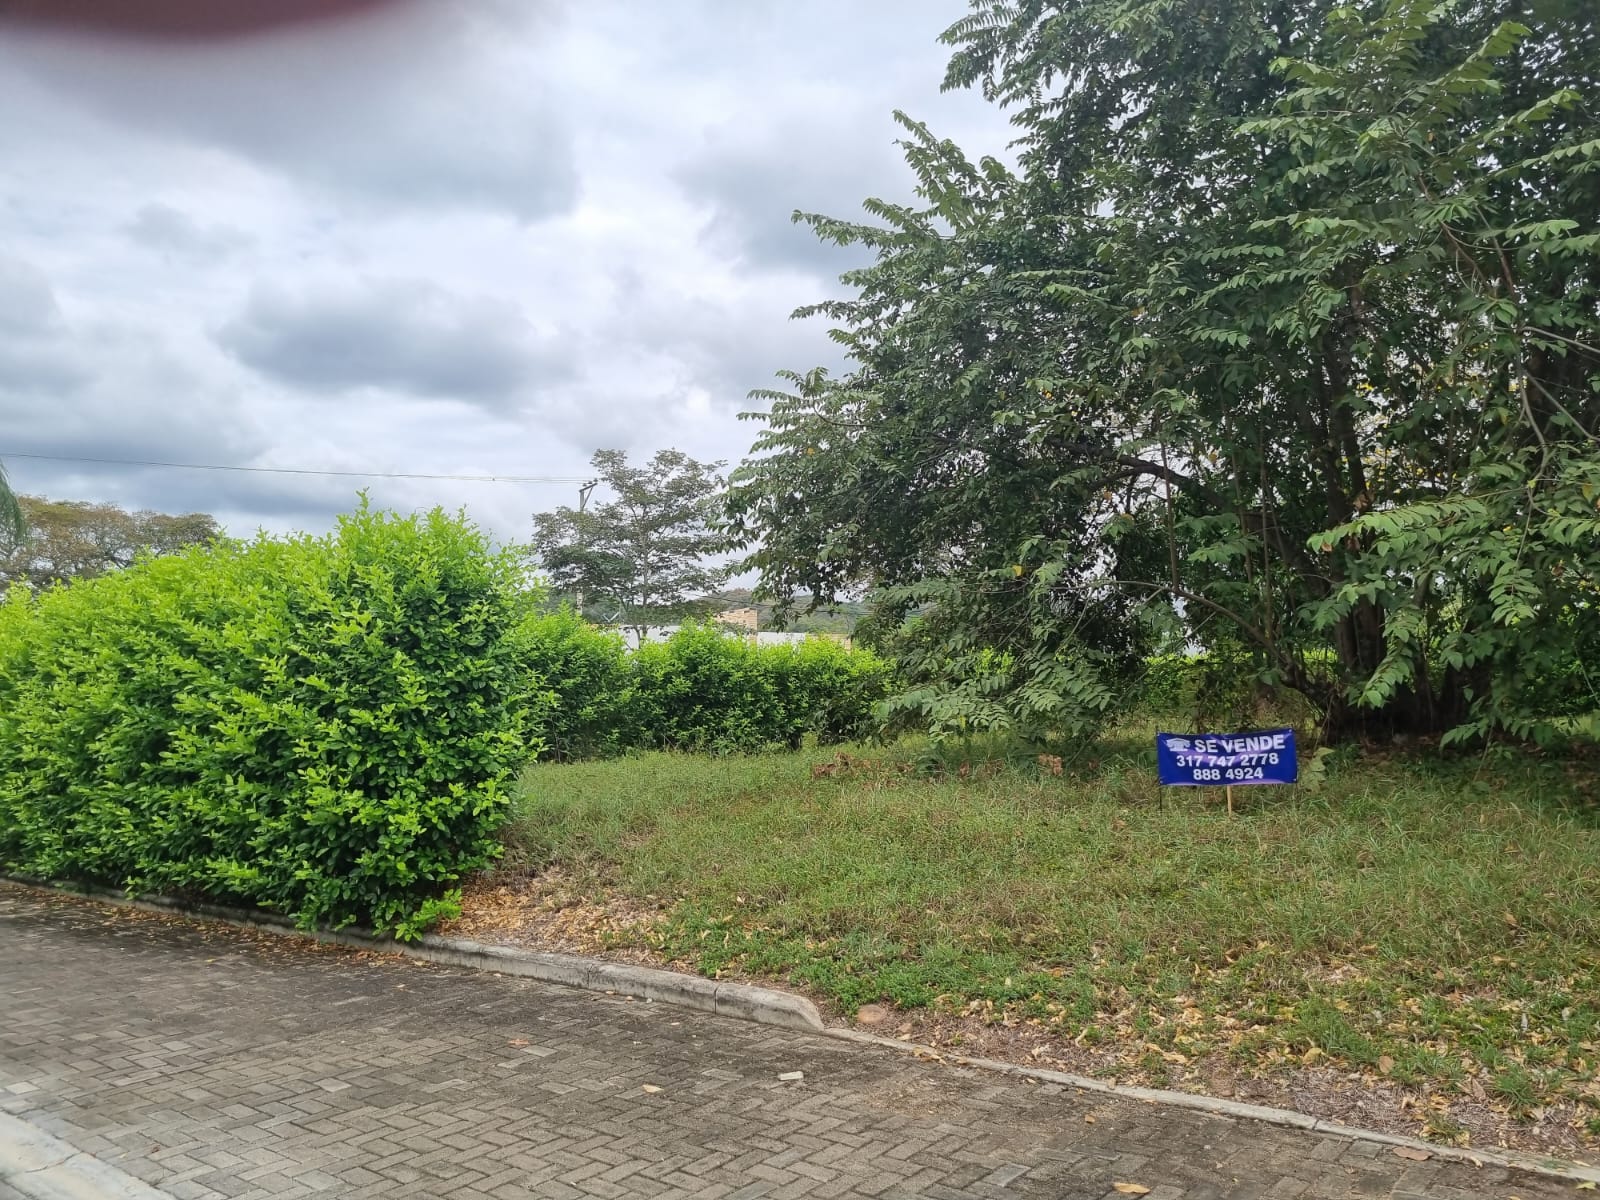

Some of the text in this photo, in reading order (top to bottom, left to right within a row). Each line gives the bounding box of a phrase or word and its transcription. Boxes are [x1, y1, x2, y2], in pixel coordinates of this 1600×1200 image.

[1194, 734, 1286, 753] SE VENDE
[1176, 752, 1279, 767] 317 747 2778
[1193, 767, 1264, 781] 888 4924
